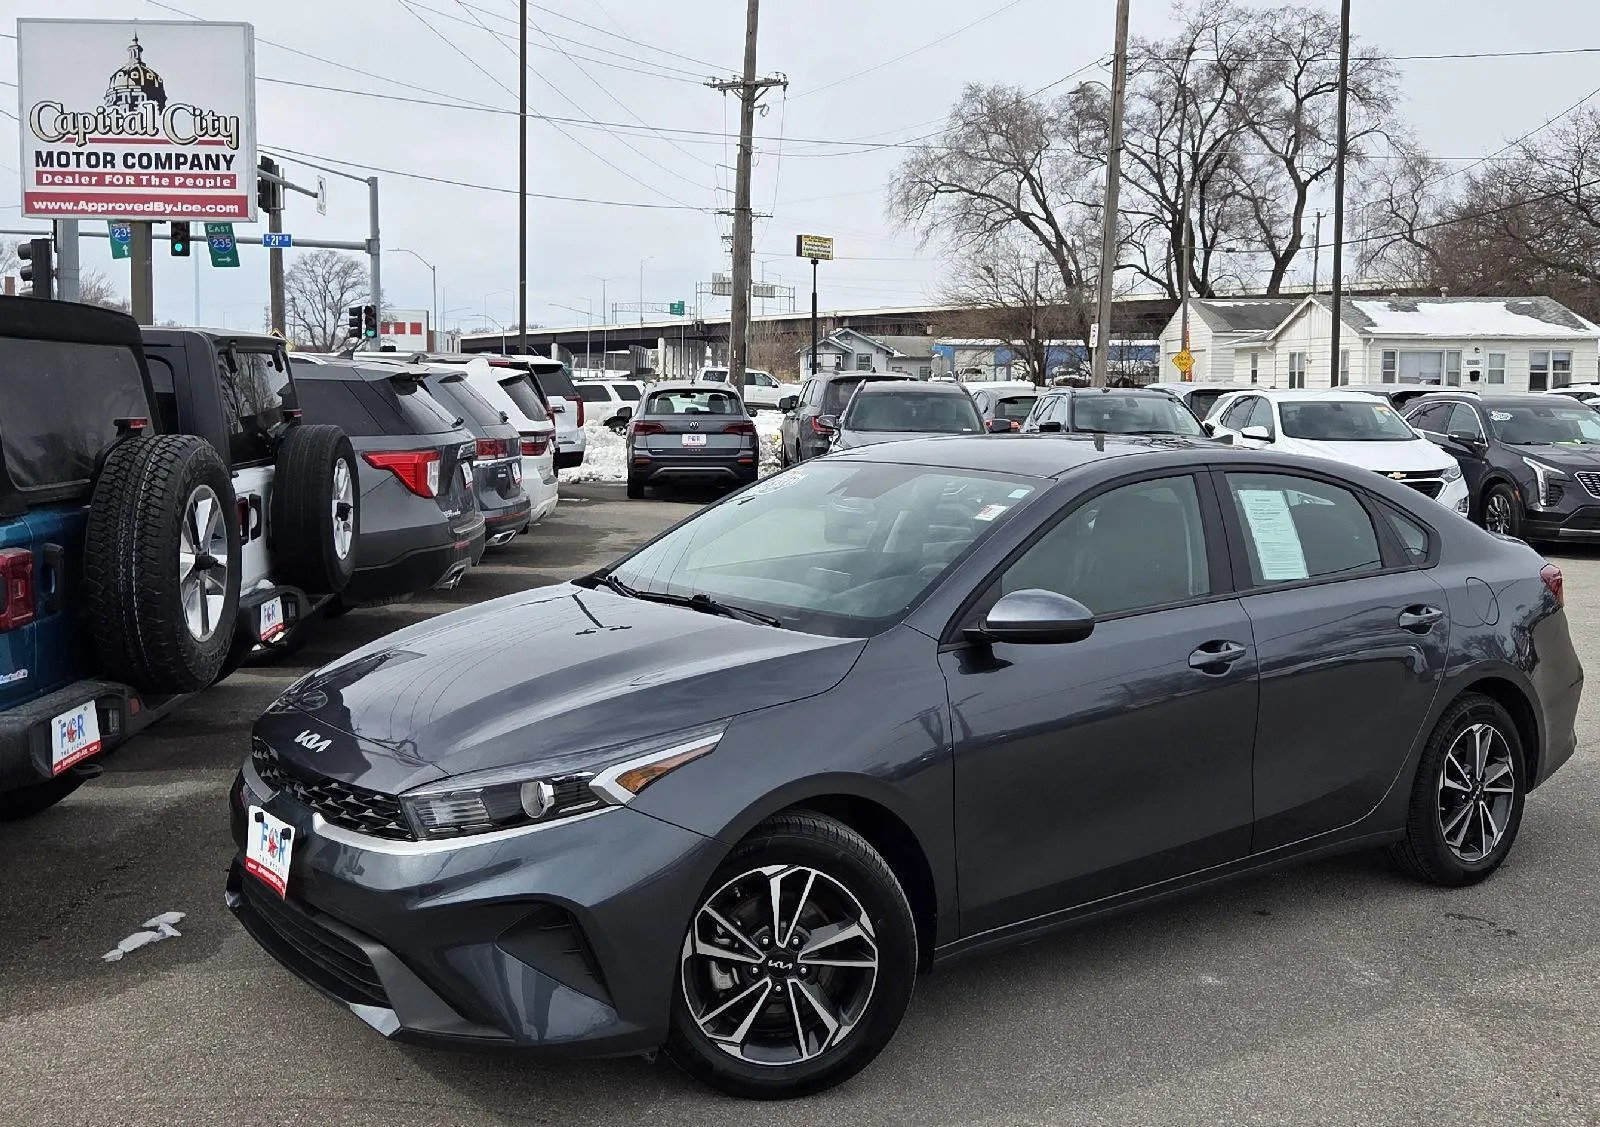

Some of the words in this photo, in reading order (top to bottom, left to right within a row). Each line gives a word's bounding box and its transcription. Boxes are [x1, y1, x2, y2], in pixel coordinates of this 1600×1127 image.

[29, 100, 159, 147] Capital
[162, 102, 239, 150] City
[34, 150, 116, 169] MOTOR
[122, 152, 235, 171] COMPANY
[42, 174, 98, 185] Dealer
[105, 175, 135, 185] FOR
[140, 175, 170, 186] The
[175, 176, 231, 188] People
[33, 200, 239, 214] www.ApprovedByJoe.com
[207, 224, 230, 233] EAST
[212, 238, 232, 248] 235
